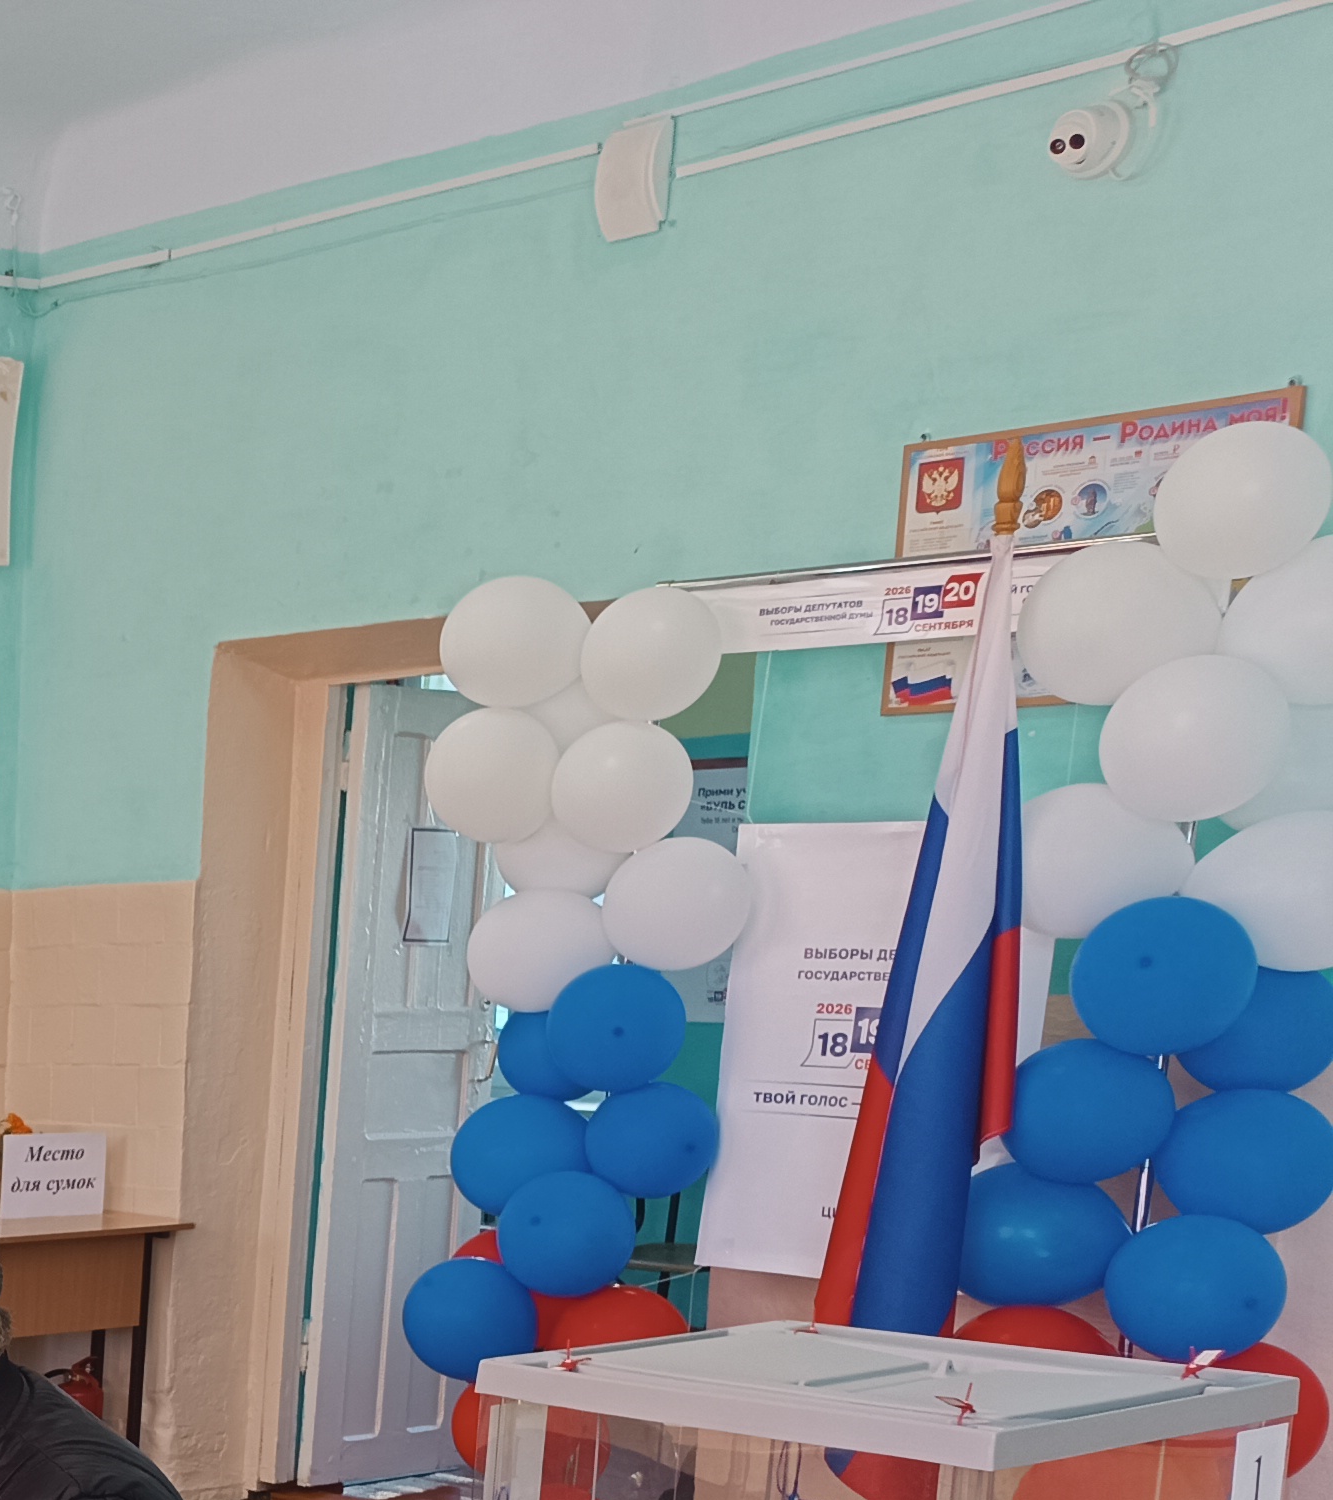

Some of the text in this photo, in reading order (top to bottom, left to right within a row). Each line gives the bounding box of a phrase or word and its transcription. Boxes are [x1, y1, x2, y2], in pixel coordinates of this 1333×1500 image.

[885, 586, 911, 595] 2026
[945, 580, 976, 601] 20
[759, 600, 863, 616] ВЫБОРЫ ДЕПУТАТОВ
[915, 593, 939, 614] 19
[770, 614, 847, 626] ГОСУДАРСТВЕННОЙ
[885, 607, 908, 627] 18
[914, 620, 973, 632] СЕНТЯБРЯ
[698, 788, 733, 798] Прими
[804, 948, 872, 959] ВЫБОРЫ
[798, 970, 890, 981] ГОСУДАРСТВЕ
[816, 1003, 852, 1014] 2026
[818, 1032, 848, 1057] 18
[754, 1090, 848, 1108] ТВОЙ ГОЛОС
[25, 1146, 84, 1162] Место
[11, 1177, 97, 1195] для сумок
